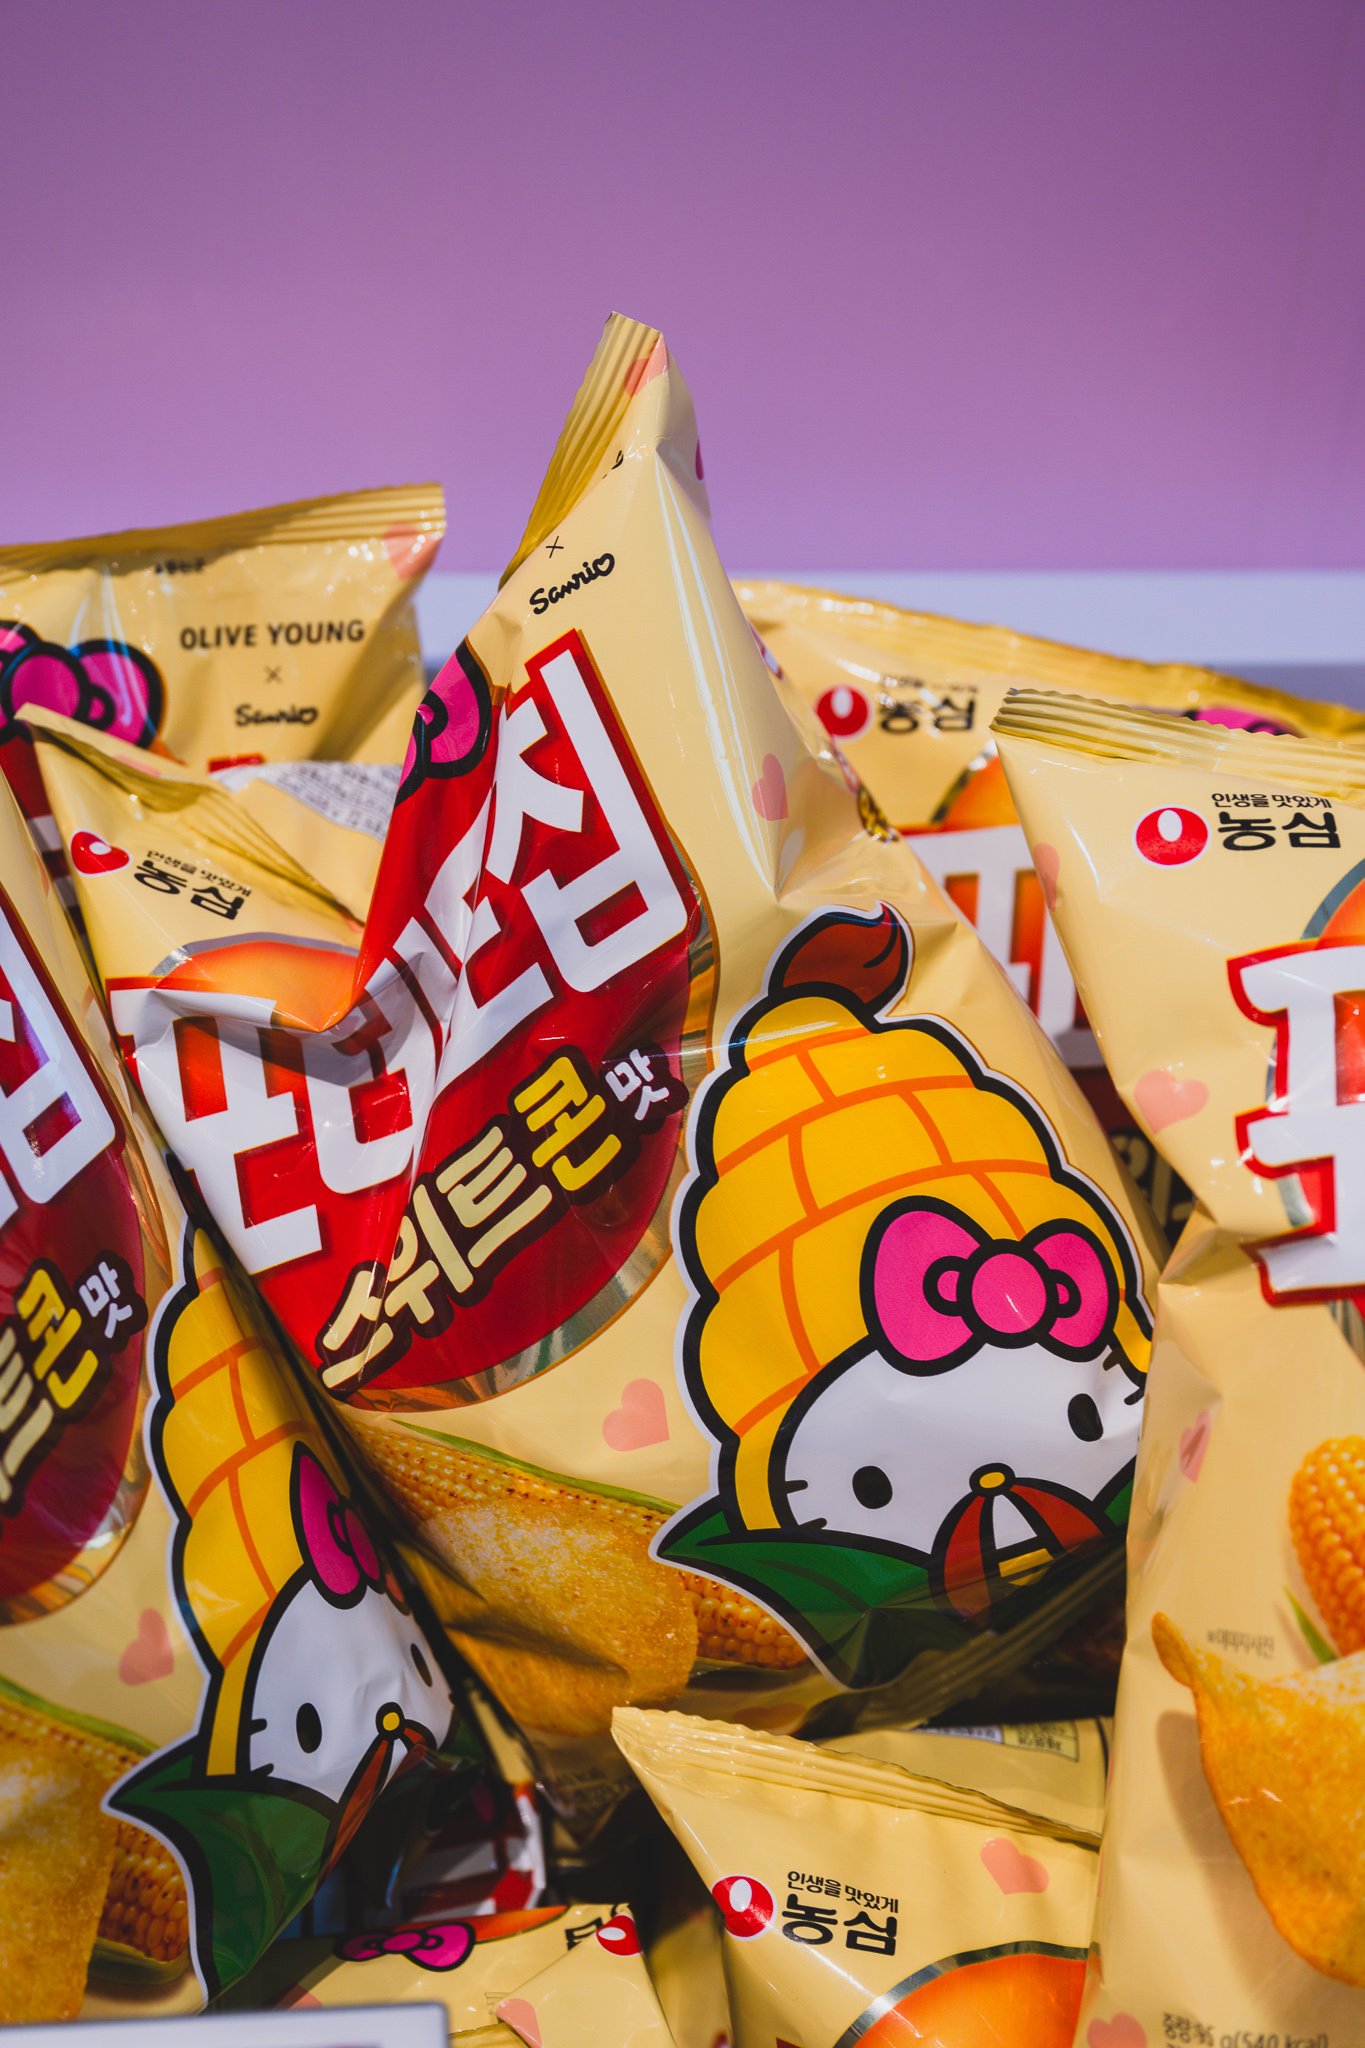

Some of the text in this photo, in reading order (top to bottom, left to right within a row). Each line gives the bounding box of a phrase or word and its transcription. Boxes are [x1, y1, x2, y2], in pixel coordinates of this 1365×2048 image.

[529, 552, 615, 615] Sanrio
[180, 619, 365, 650] OLIVE YOUNG
[1211, 793, 1333, 808] 인생을 맛있게
[1218, 811, 1341, 851] 농심
[134, 859, 245, 920] 농심
[787, 1871, 899, 1914] 인생을 맛있게
[782, 1893, 898, 1956] 농심
